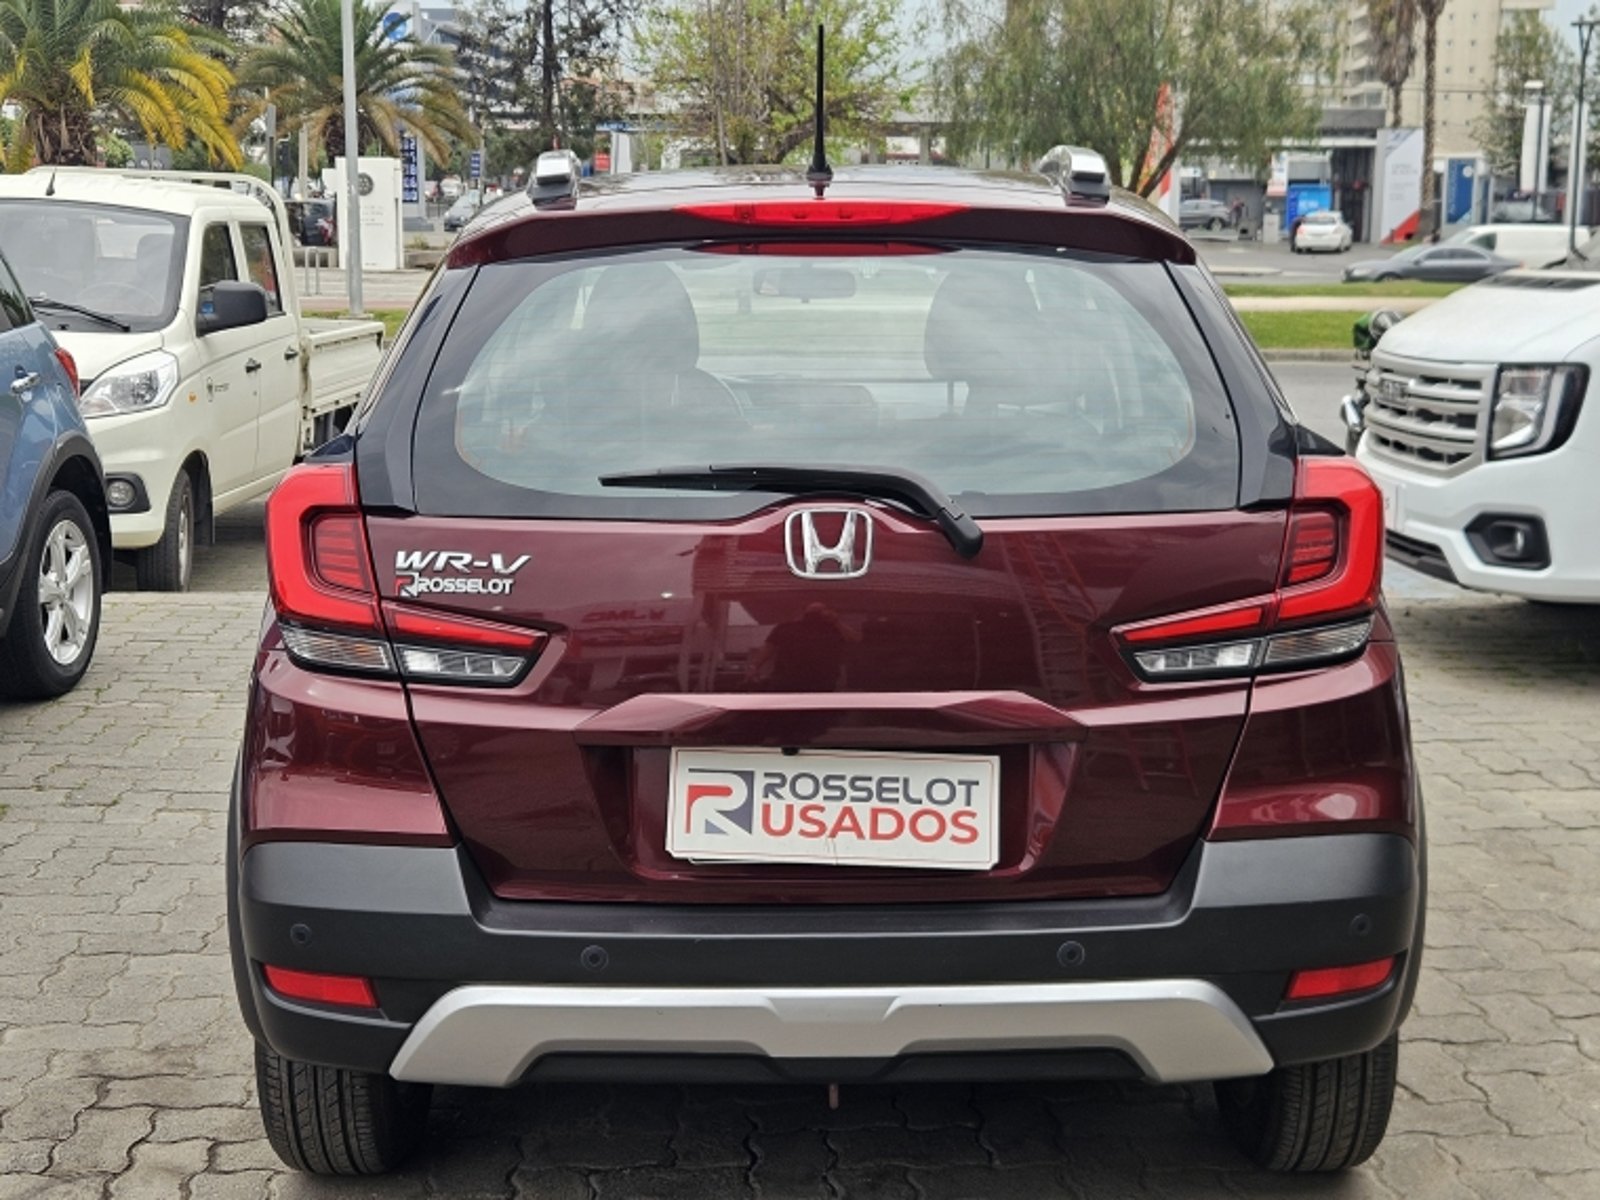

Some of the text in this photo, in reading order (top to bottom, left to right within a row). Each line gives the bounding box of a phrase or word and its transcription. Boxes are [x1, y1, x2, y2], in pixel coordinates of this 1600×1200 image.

[395, 550, 531, 575] WR-V
[418, 577, 514, 595] ROSSELOT
[763, 772, 980, 807] ROSSELOT
[761, 803, 980, 845] USADOS
